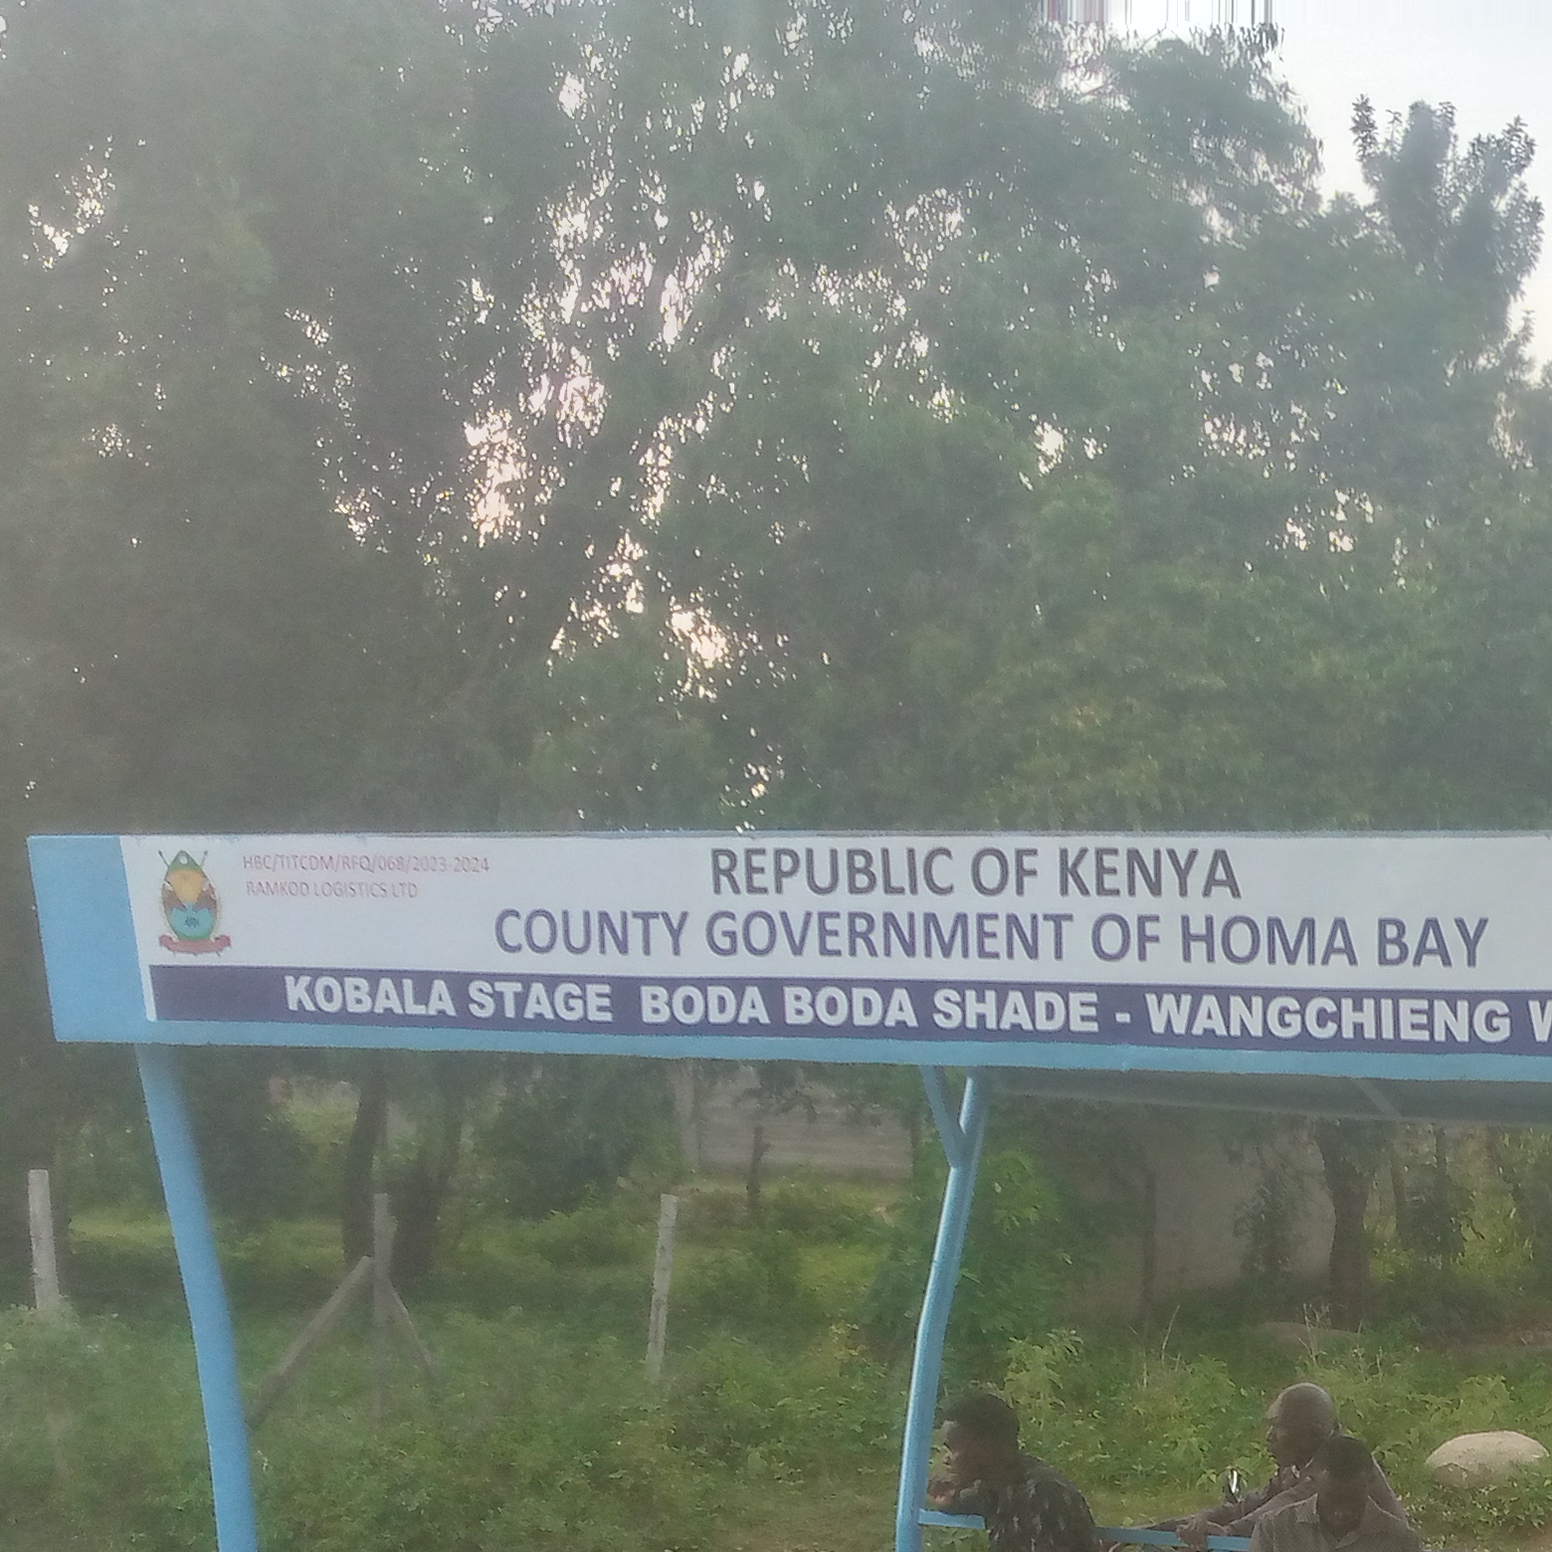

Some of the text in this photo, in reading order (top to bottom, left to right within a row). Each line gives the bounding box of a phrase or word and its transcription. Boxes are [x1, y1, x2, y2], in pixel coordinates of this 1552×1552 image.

[313, 881, 387, 898] LOGISTICS
[391, 882, 418, 898] LTD
[711, 847, 1242, 898] REPUBLIC OF KENYA
[496, 909, 1489, 968] COUNTY GOVERNMENT OF HOMA BAY
[284, 975, 457, 1018] KOBALA
[467, 981, 613, 1022] STAGE
[640, 986, 771, 1025] BODA
[783, 986, 918, 1028] BODA
[933, 988, 1099, 1034] SHADE
[1115, 1011, 1132, 1023] -
[1145, 993, 1512, 1043] WANGCHIENG
